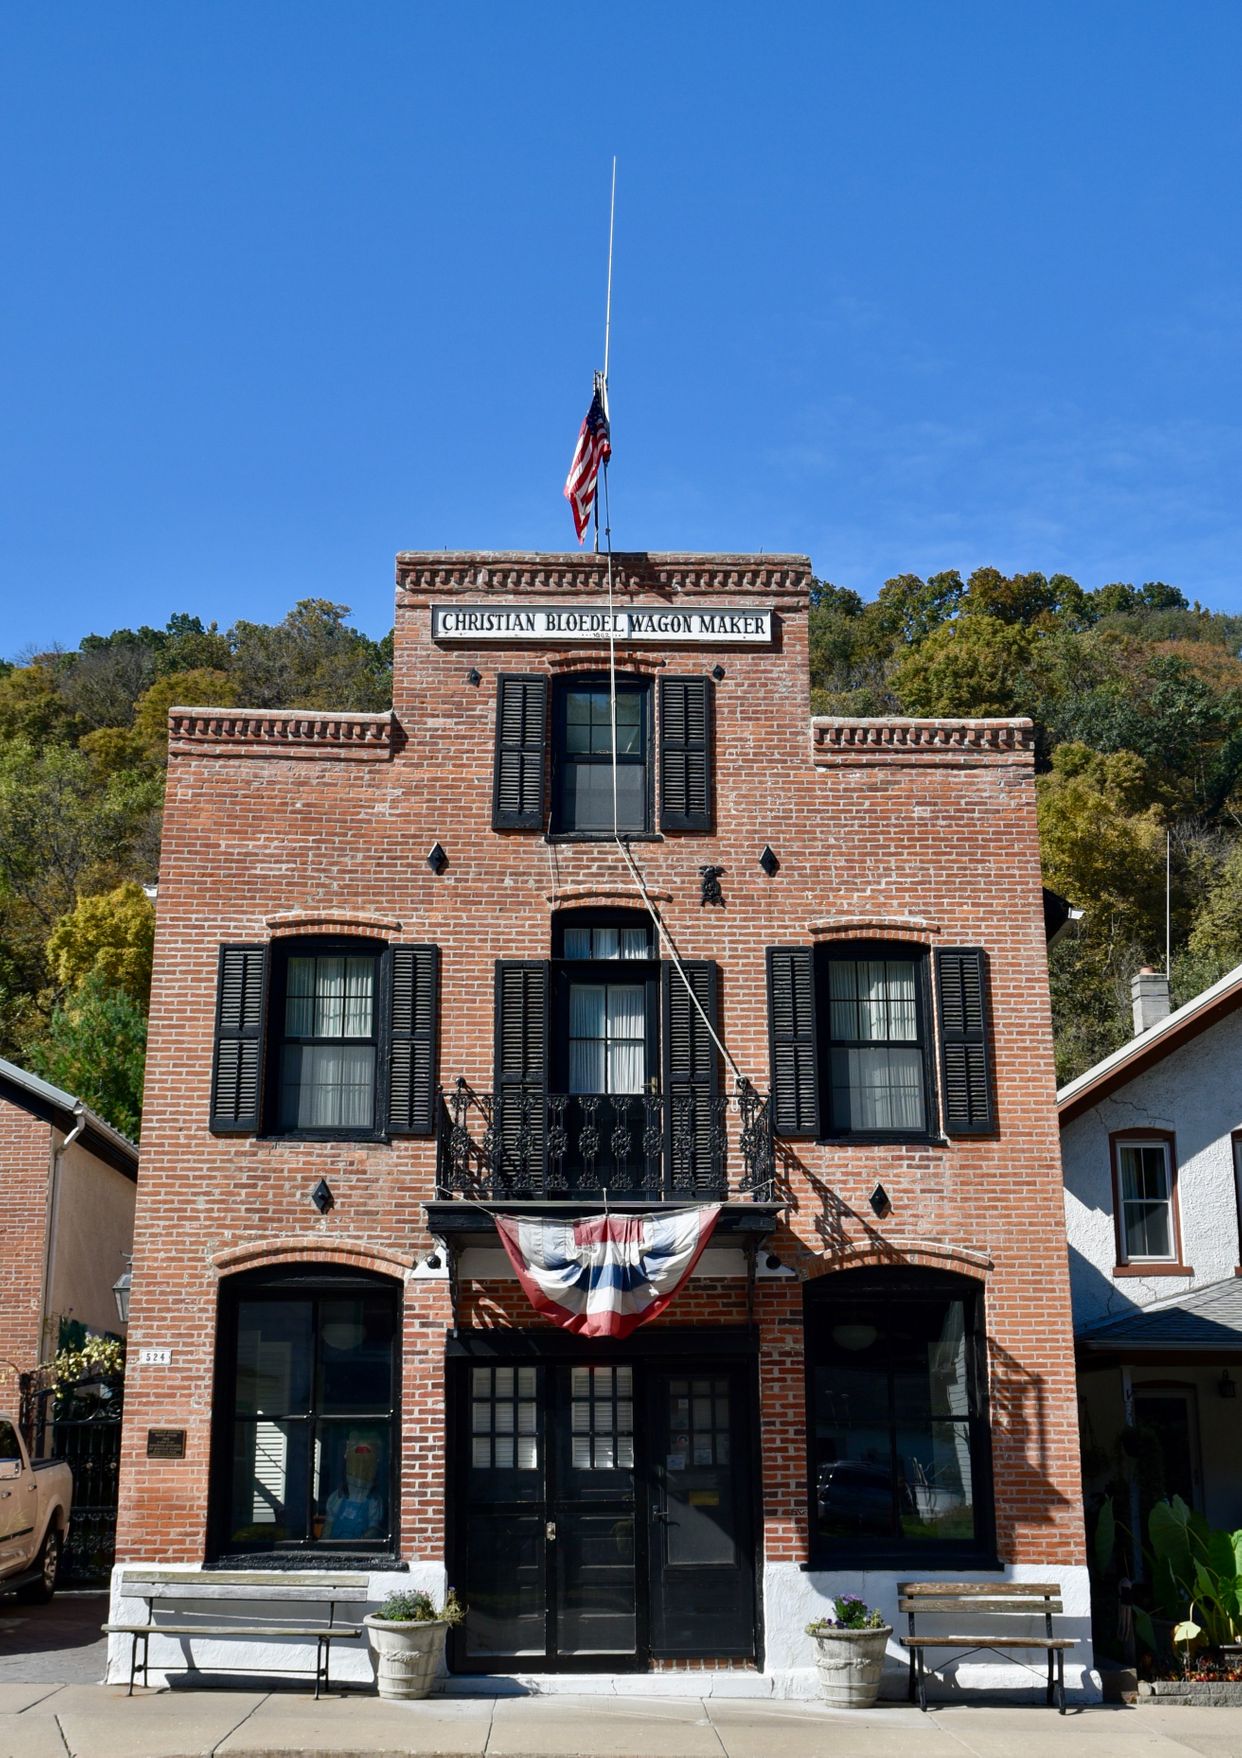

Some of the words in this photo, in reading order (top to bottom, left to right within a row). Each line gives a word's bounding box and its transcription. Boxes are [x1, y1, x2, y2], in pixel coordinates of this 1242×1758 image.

[443, 613, 536, 631] CHRISTIAN
[545, 613, 624, 632] BLOEDEL
[629, 614, 692, 633] WAGON
[699, 615, 766, 634] MAKER
[146, 1352, 165, 1362] 524
